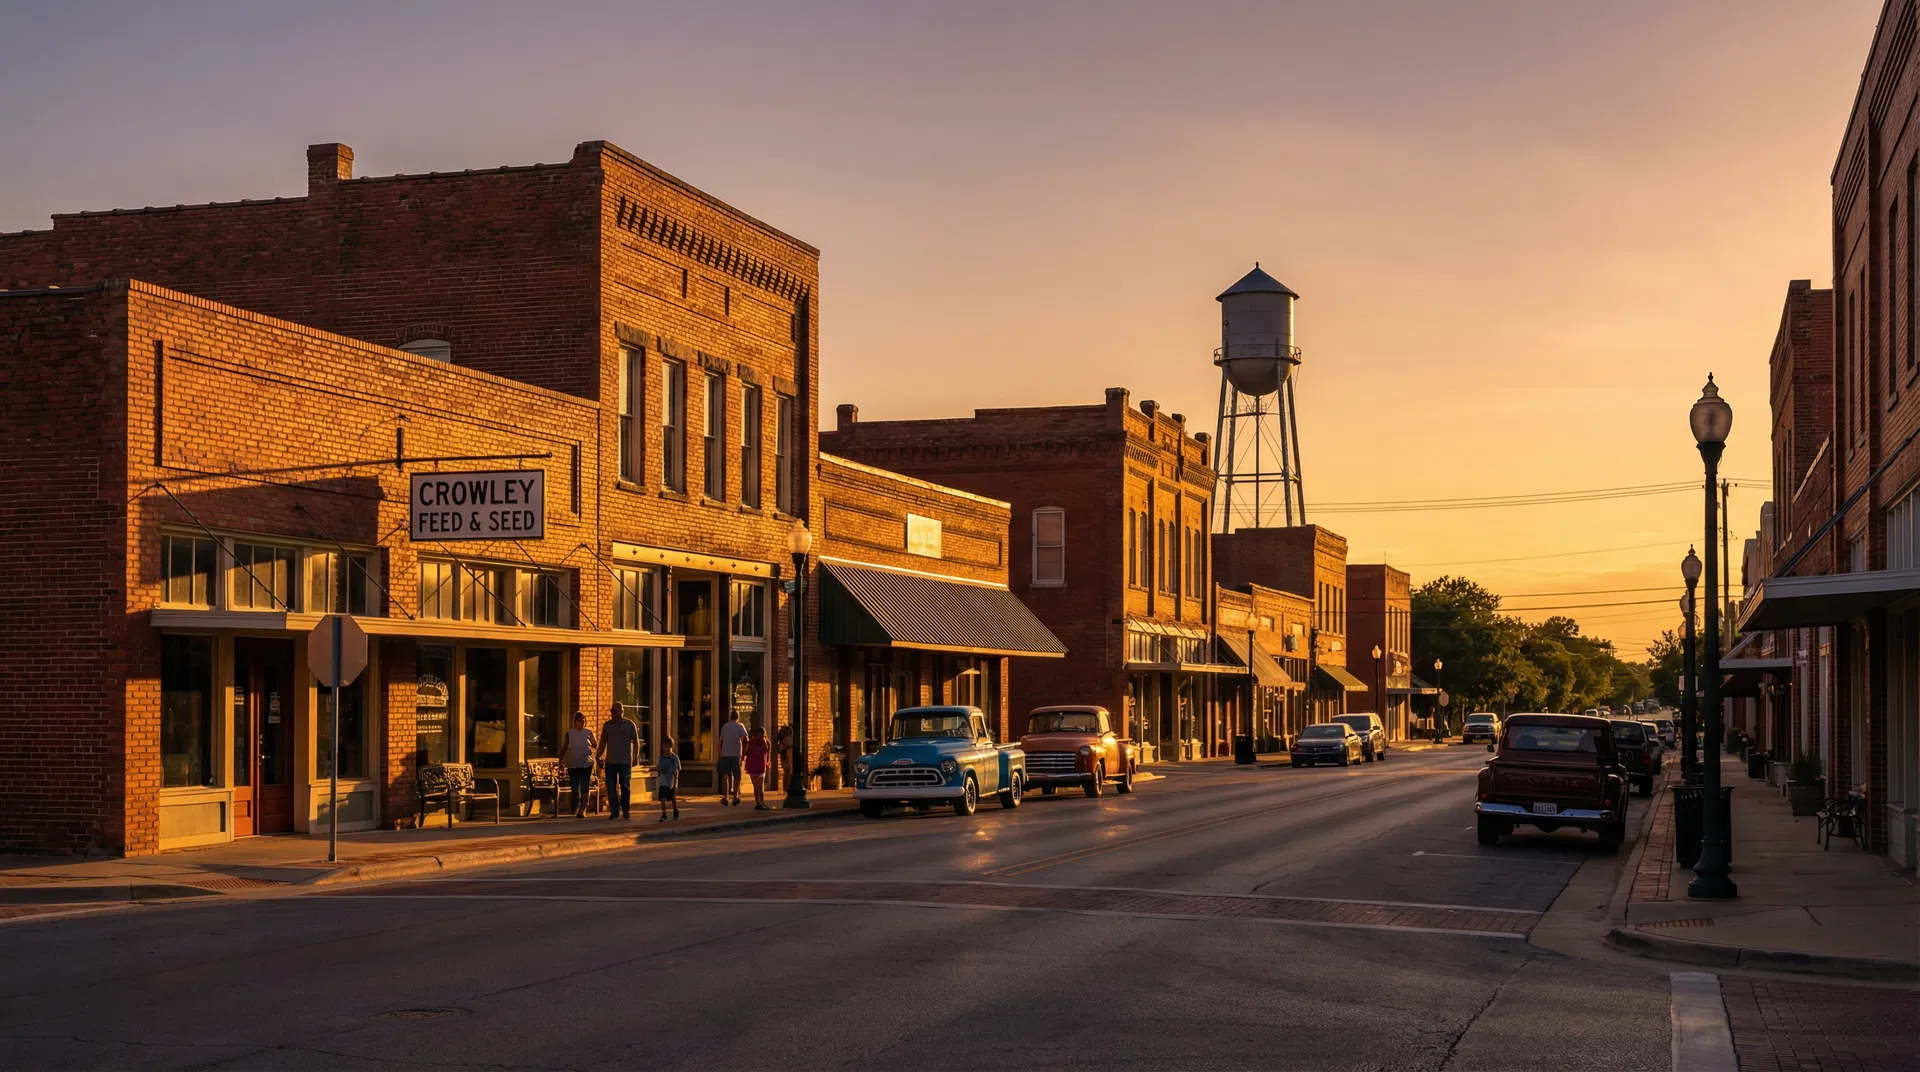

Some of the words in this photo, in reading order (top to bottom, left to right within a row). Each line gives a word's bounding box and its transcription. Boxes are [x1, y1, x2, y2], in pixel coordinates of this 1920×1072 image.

[419, 479, 535, 506] CROWLEY
[419, 511, 463, 533] FEED
[469, 511, 481, 532] &
[488, 510, 535, 532] SEED
